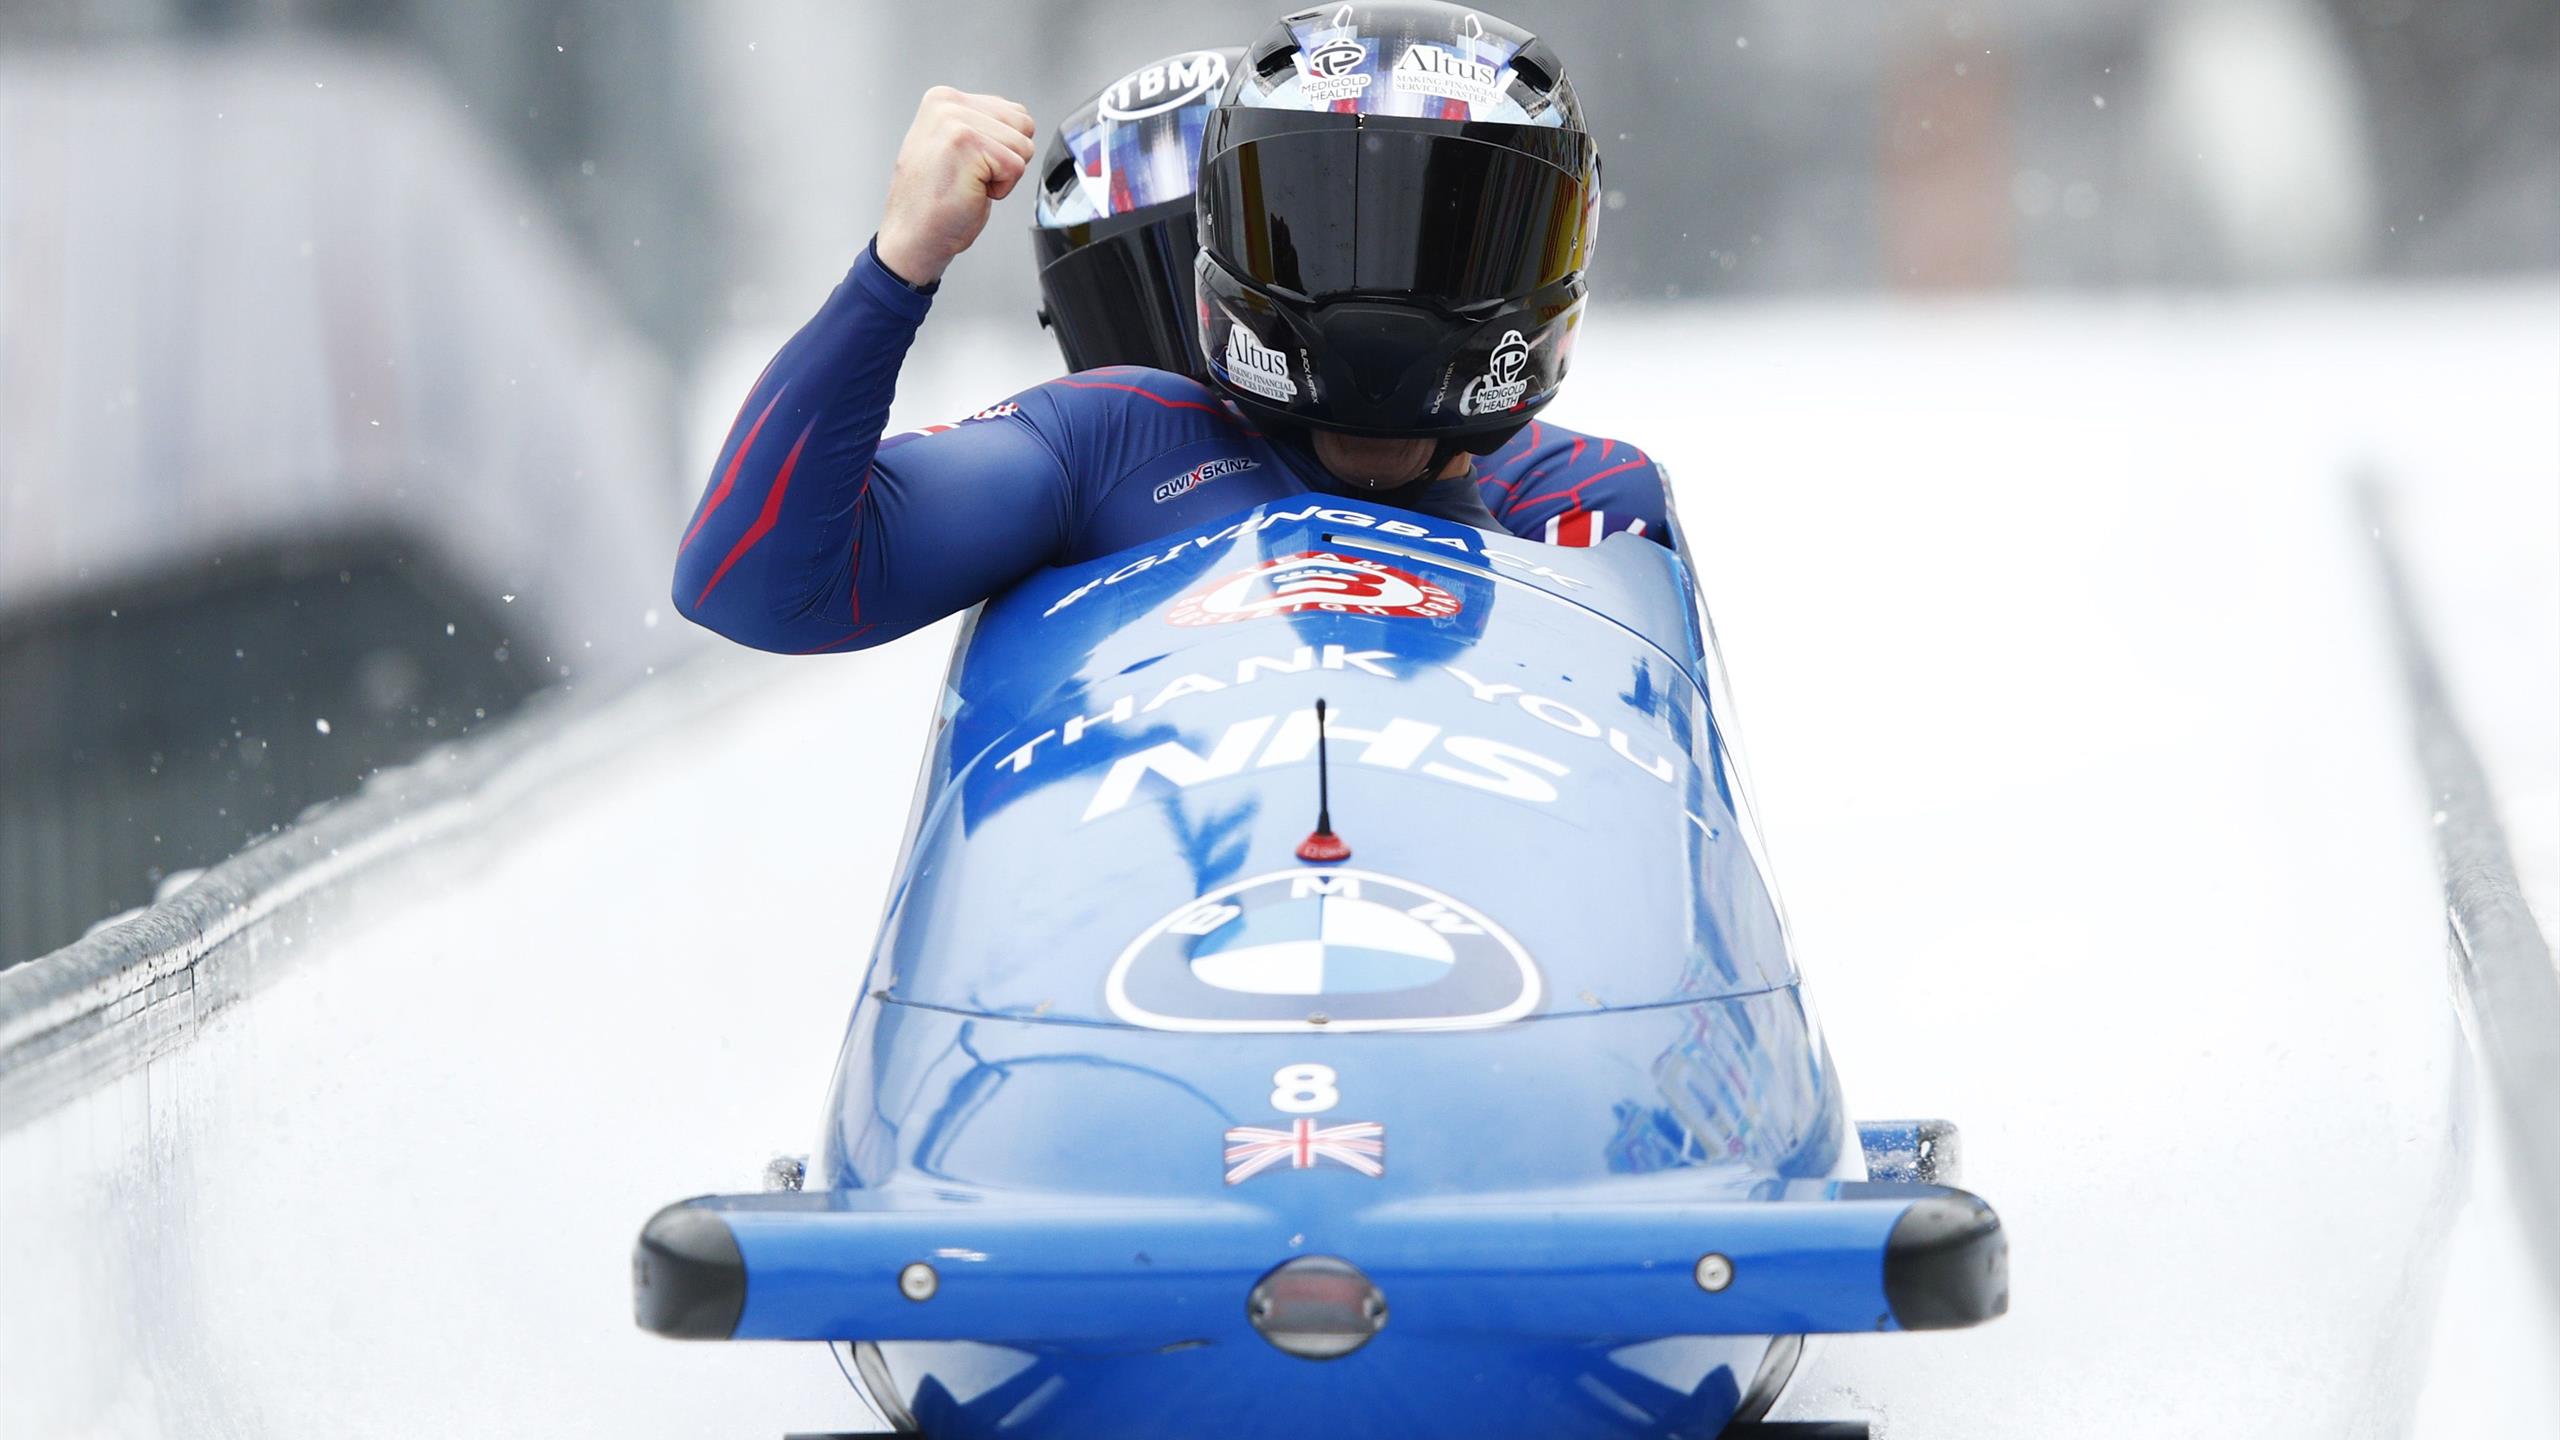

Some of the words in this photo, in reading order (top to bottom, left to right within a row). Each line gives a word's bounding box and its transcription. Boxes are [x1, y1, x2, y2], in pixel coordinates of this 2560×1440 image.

[1399, 48, 1492, 85] Altus
[1110, 56, 1213, 109] TBM
[1302, 76, 1368, 94] MEDIGOLD
[1310, 88, 1359, 101] HEALTH
[1396, 75, 1442, 86] MAKING
[1444, 80, 1498, 99] FINANCIAL
[1449, 88, 1488, 104] FASTER
[1228, 328, 1285, 376] Altus
[1253, 374, 1295, 392] FINANCIAL
[1258, 386, 1286, 400] FASTER
[1480, 383, 1525, 400] MEDIGOLD
[1483, 395, 1517, 411] HEALTH
[1043, 506, 1592, 618] #GIVINGBACK
[996, 645, 1401, 774] THANK
[1444, 666, 1675, 783] YOU
[1080, 708, 1572, 823] NHS
[1166, 876, 1486, 936] BMW
[1270, 1063, 1340, 1113] 8
